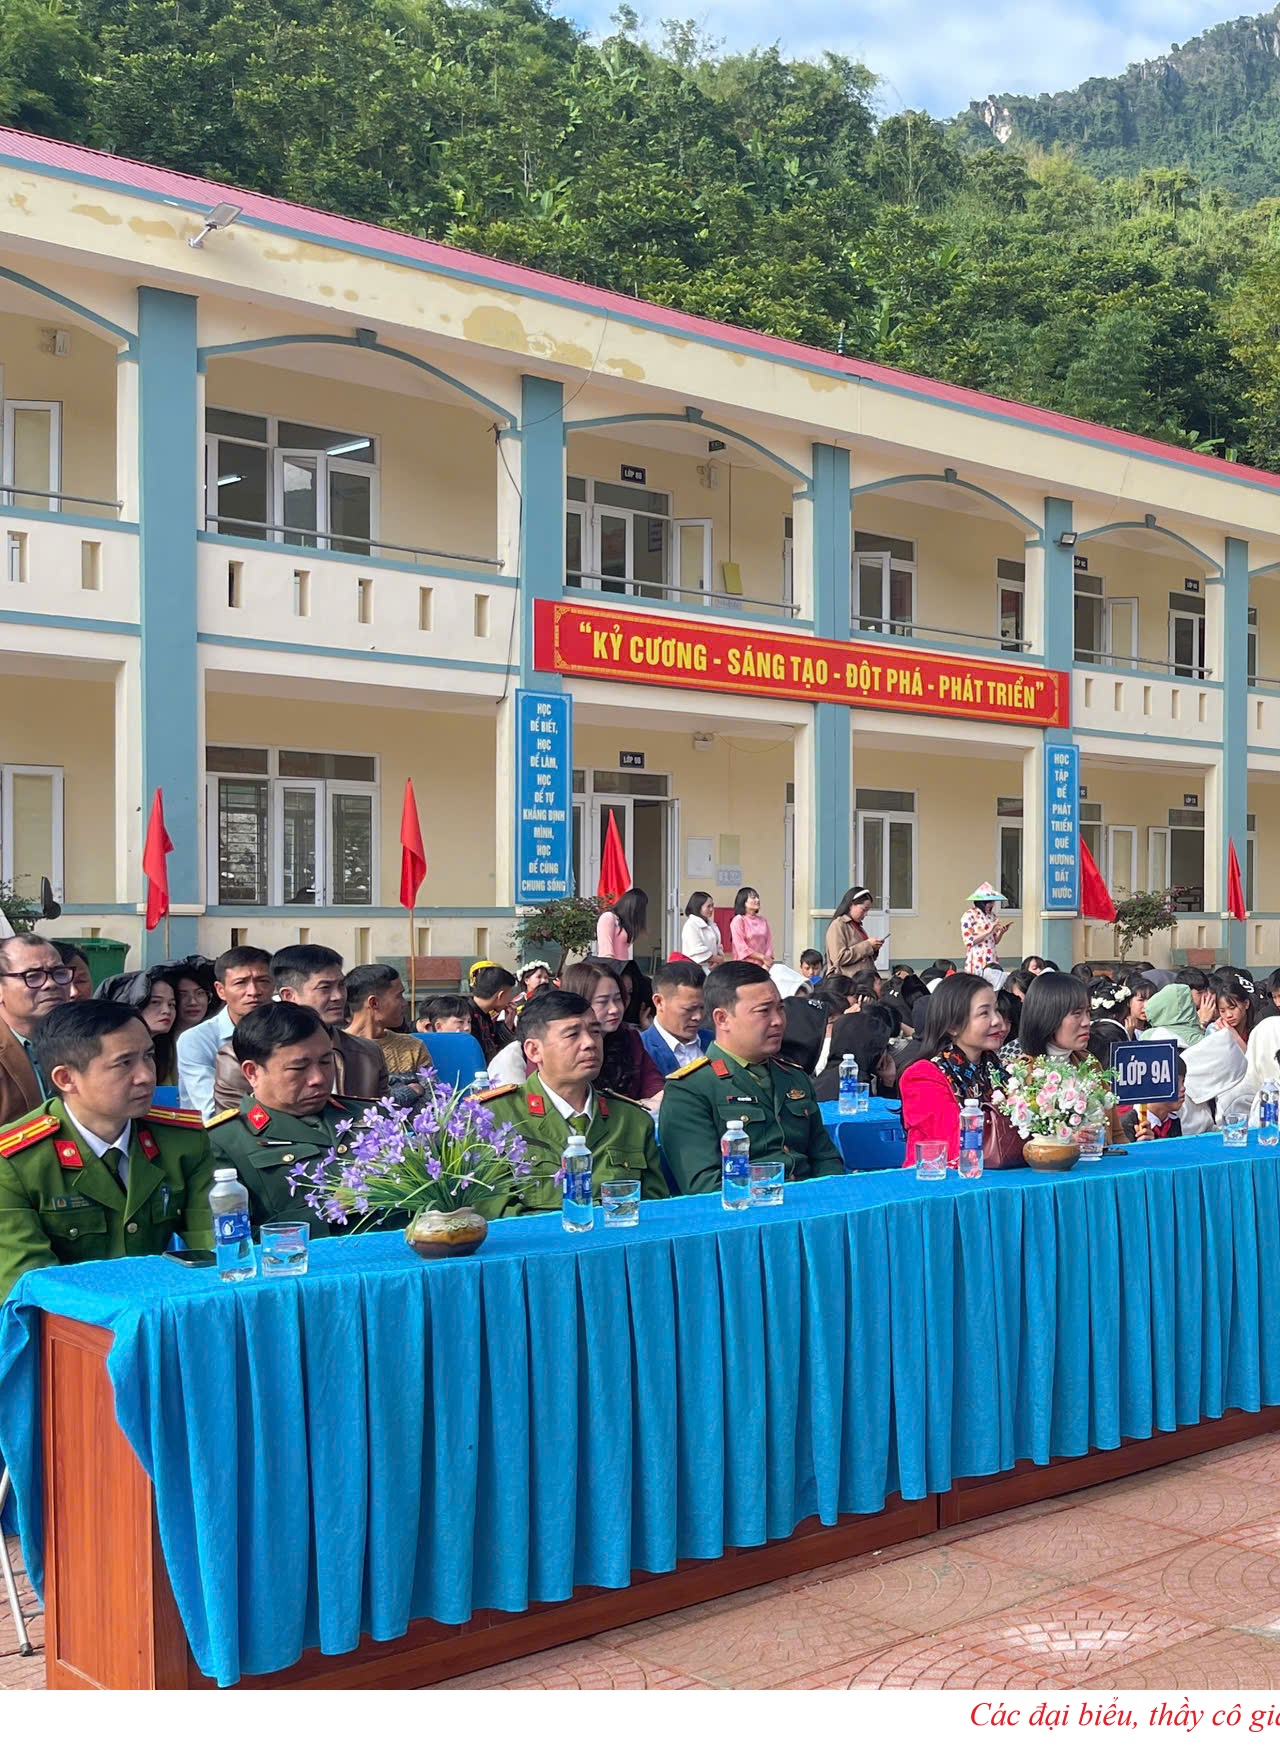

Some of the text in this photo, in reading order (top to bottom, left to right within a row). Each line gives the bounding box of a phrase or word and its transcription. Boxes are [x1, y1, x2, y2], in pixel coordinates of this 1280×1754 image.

[629, 635, 708, 671] CƯƠNG
[728, 645, 785, 681] SÁNG
[790, 656, 828, 688] TẠO
[845, 660, 882, 695] ĐỘT
[887, 667, 923, 697] PHÁ
[939, 673, 983, 704] PHÁT
[537, 703, 551, 717] HỌC
[541, 718, 558, 734] BIẾT,
[537, 738, 551, 752] HỌC
[1054, 753, 1069, 767] HỌC
[537, 774, 551, 788] HỌC
[1055, 768, 1069, 784] TẬP
[1052, 803, 1072, 816] PHÁT
[1055, 836, 1069, 850] QUÊ
[536, 845, 551, 859] HỌC
[1118, 1055, 1171, 1086] LỚP 9A
